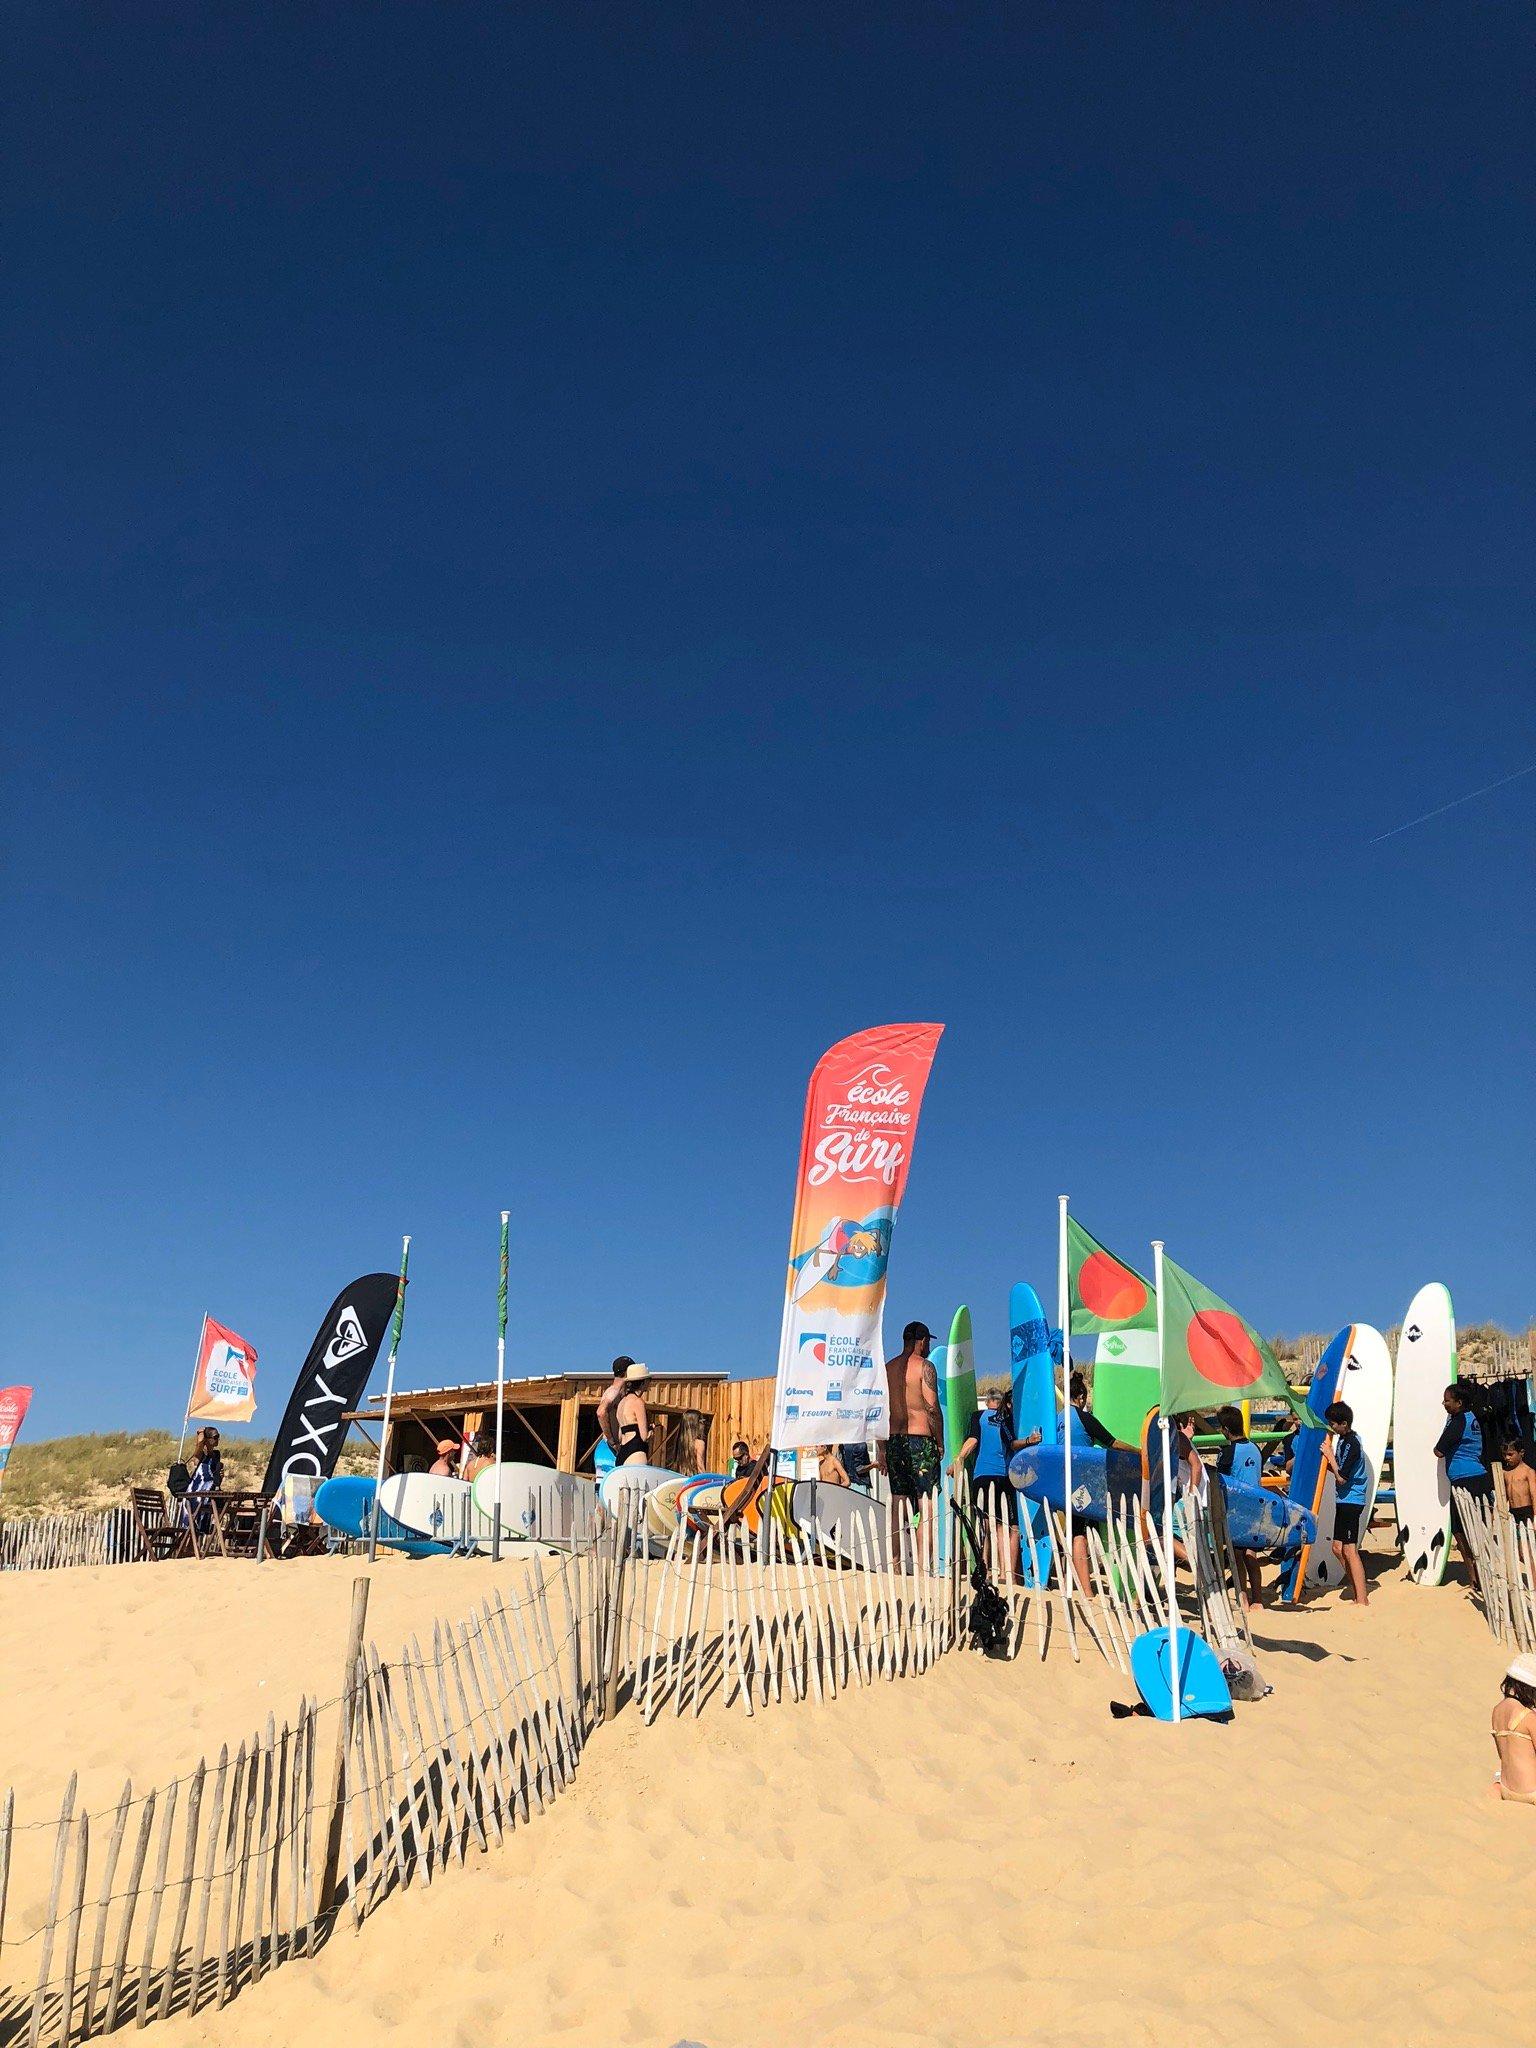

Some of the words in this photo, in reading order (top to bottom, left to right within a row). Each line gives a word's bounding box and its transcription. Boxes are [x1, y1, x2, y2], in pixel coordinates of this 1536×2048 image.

[848, 1080, 910, 1106] école
[826, 1104, 911, 1126] Française
[854, 1128, 871, 1142] de
[808, 1132, 905, 1186] Surf
[210, 1382, 237, 1395] SURF
[282, 1373, 348, 1481] OXY
